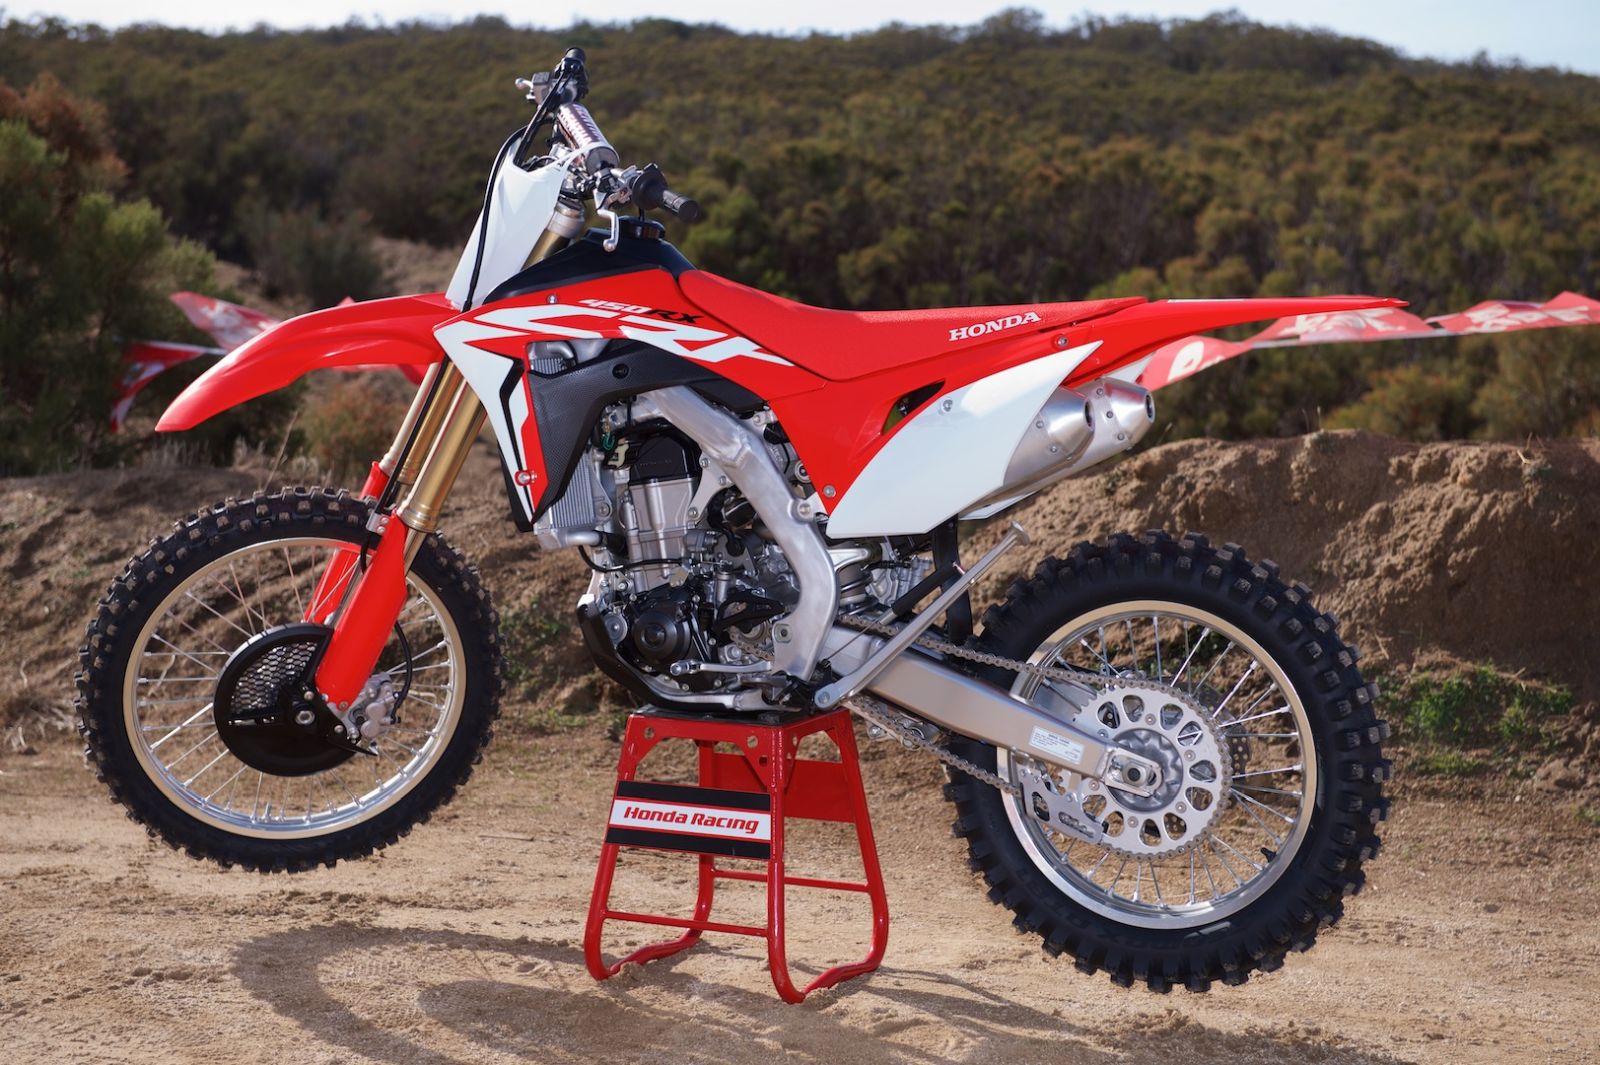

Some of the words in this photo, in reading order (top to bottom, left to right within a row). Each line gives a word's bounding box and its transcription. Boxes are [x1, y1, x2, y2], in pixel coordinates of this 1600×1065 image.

[948, 311, 1041, 341] HONDA
[624, 806, 688, 824] Honda
[690, 813, 760, 834] Racing
